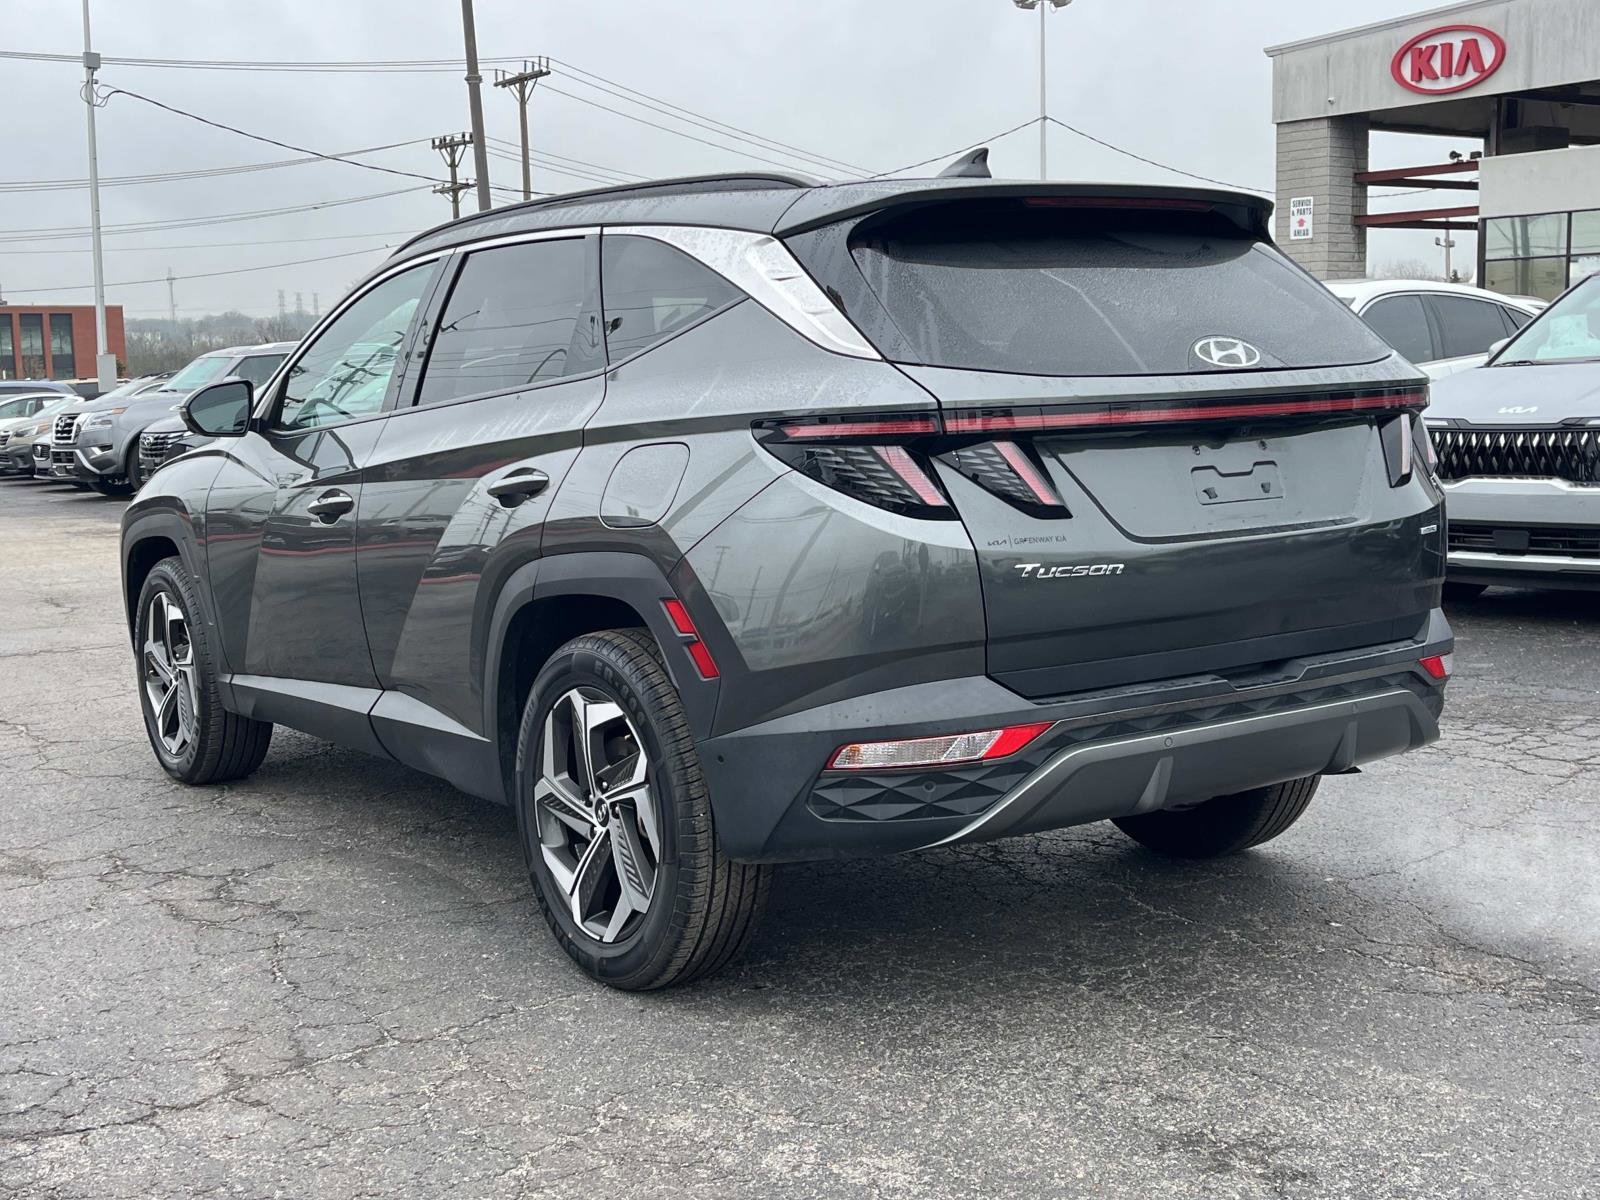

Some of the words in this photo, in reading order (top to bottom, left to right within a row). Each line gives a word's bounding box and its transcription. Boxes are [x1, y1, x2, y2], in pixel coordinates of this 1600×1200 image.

[1410, 38, 1486, 82] KIA
[1013, 536, 1054, 546] GREENWAY
[1054, 534, 1068, 543] KIA
